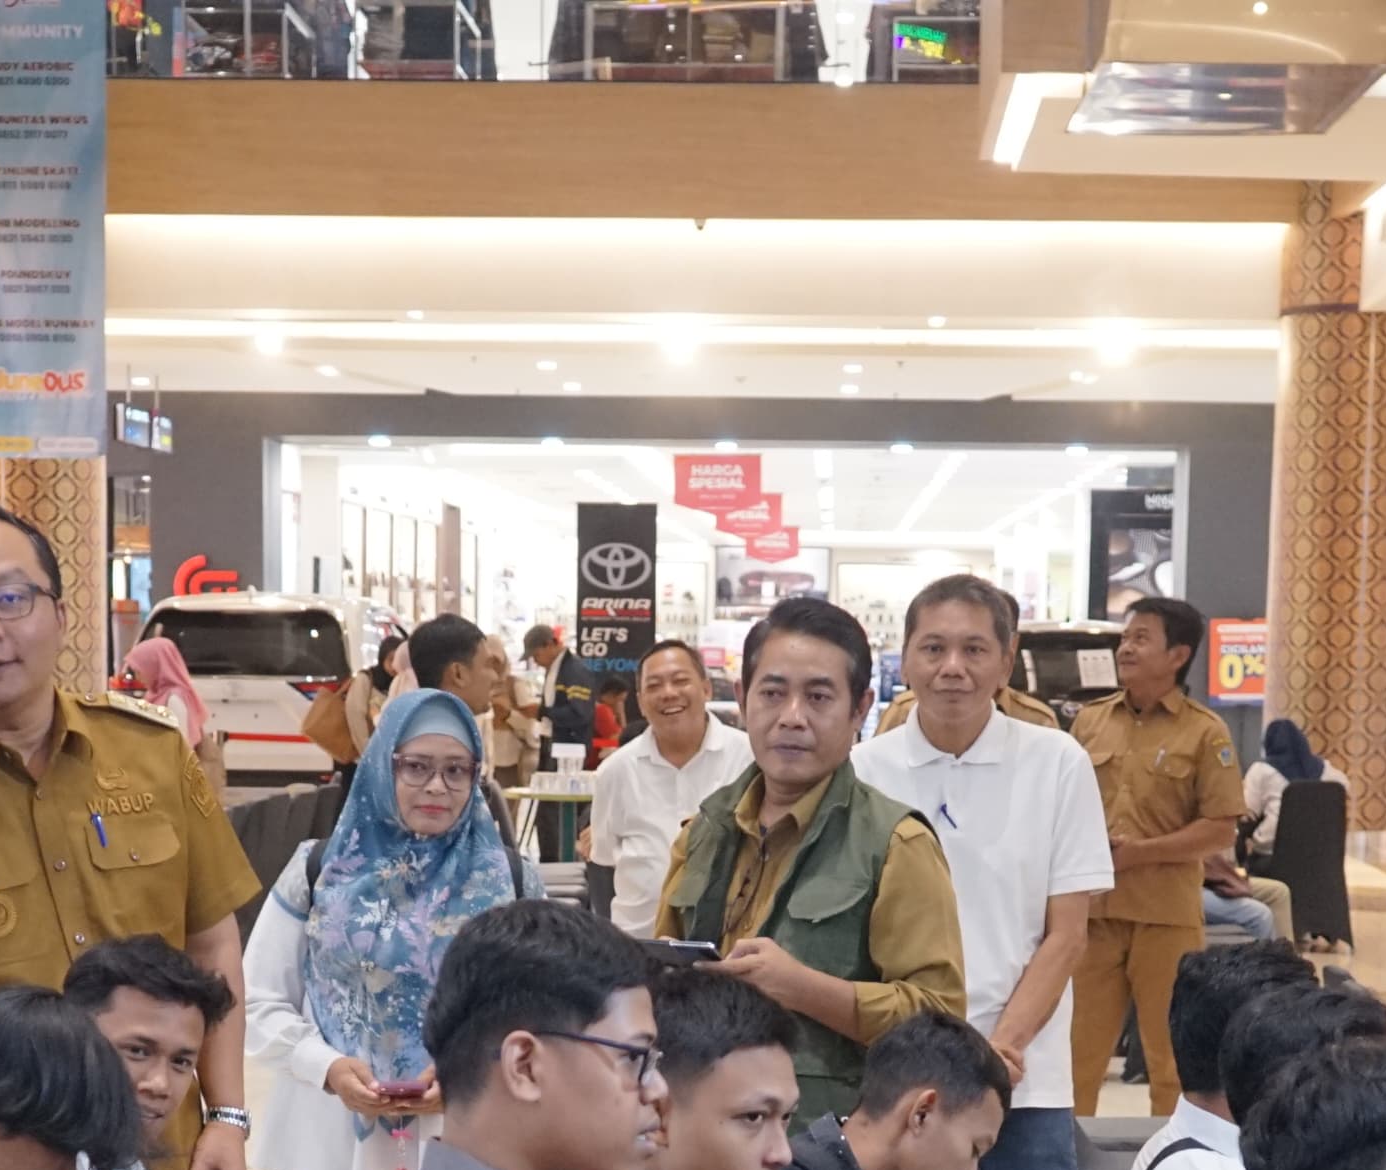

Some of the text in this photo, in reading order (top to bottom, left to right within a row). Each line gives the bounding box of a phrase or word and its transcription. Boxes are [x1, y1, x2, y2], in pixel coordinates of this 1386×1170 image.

[690, 464, 744, 476] HARGA
[687, 477, 746, 489] SPESIAL
[581, 627, 629, 643] LET'S
[581, 642, 608, 657] GO
[86, 793, 154, 816] WABUP
